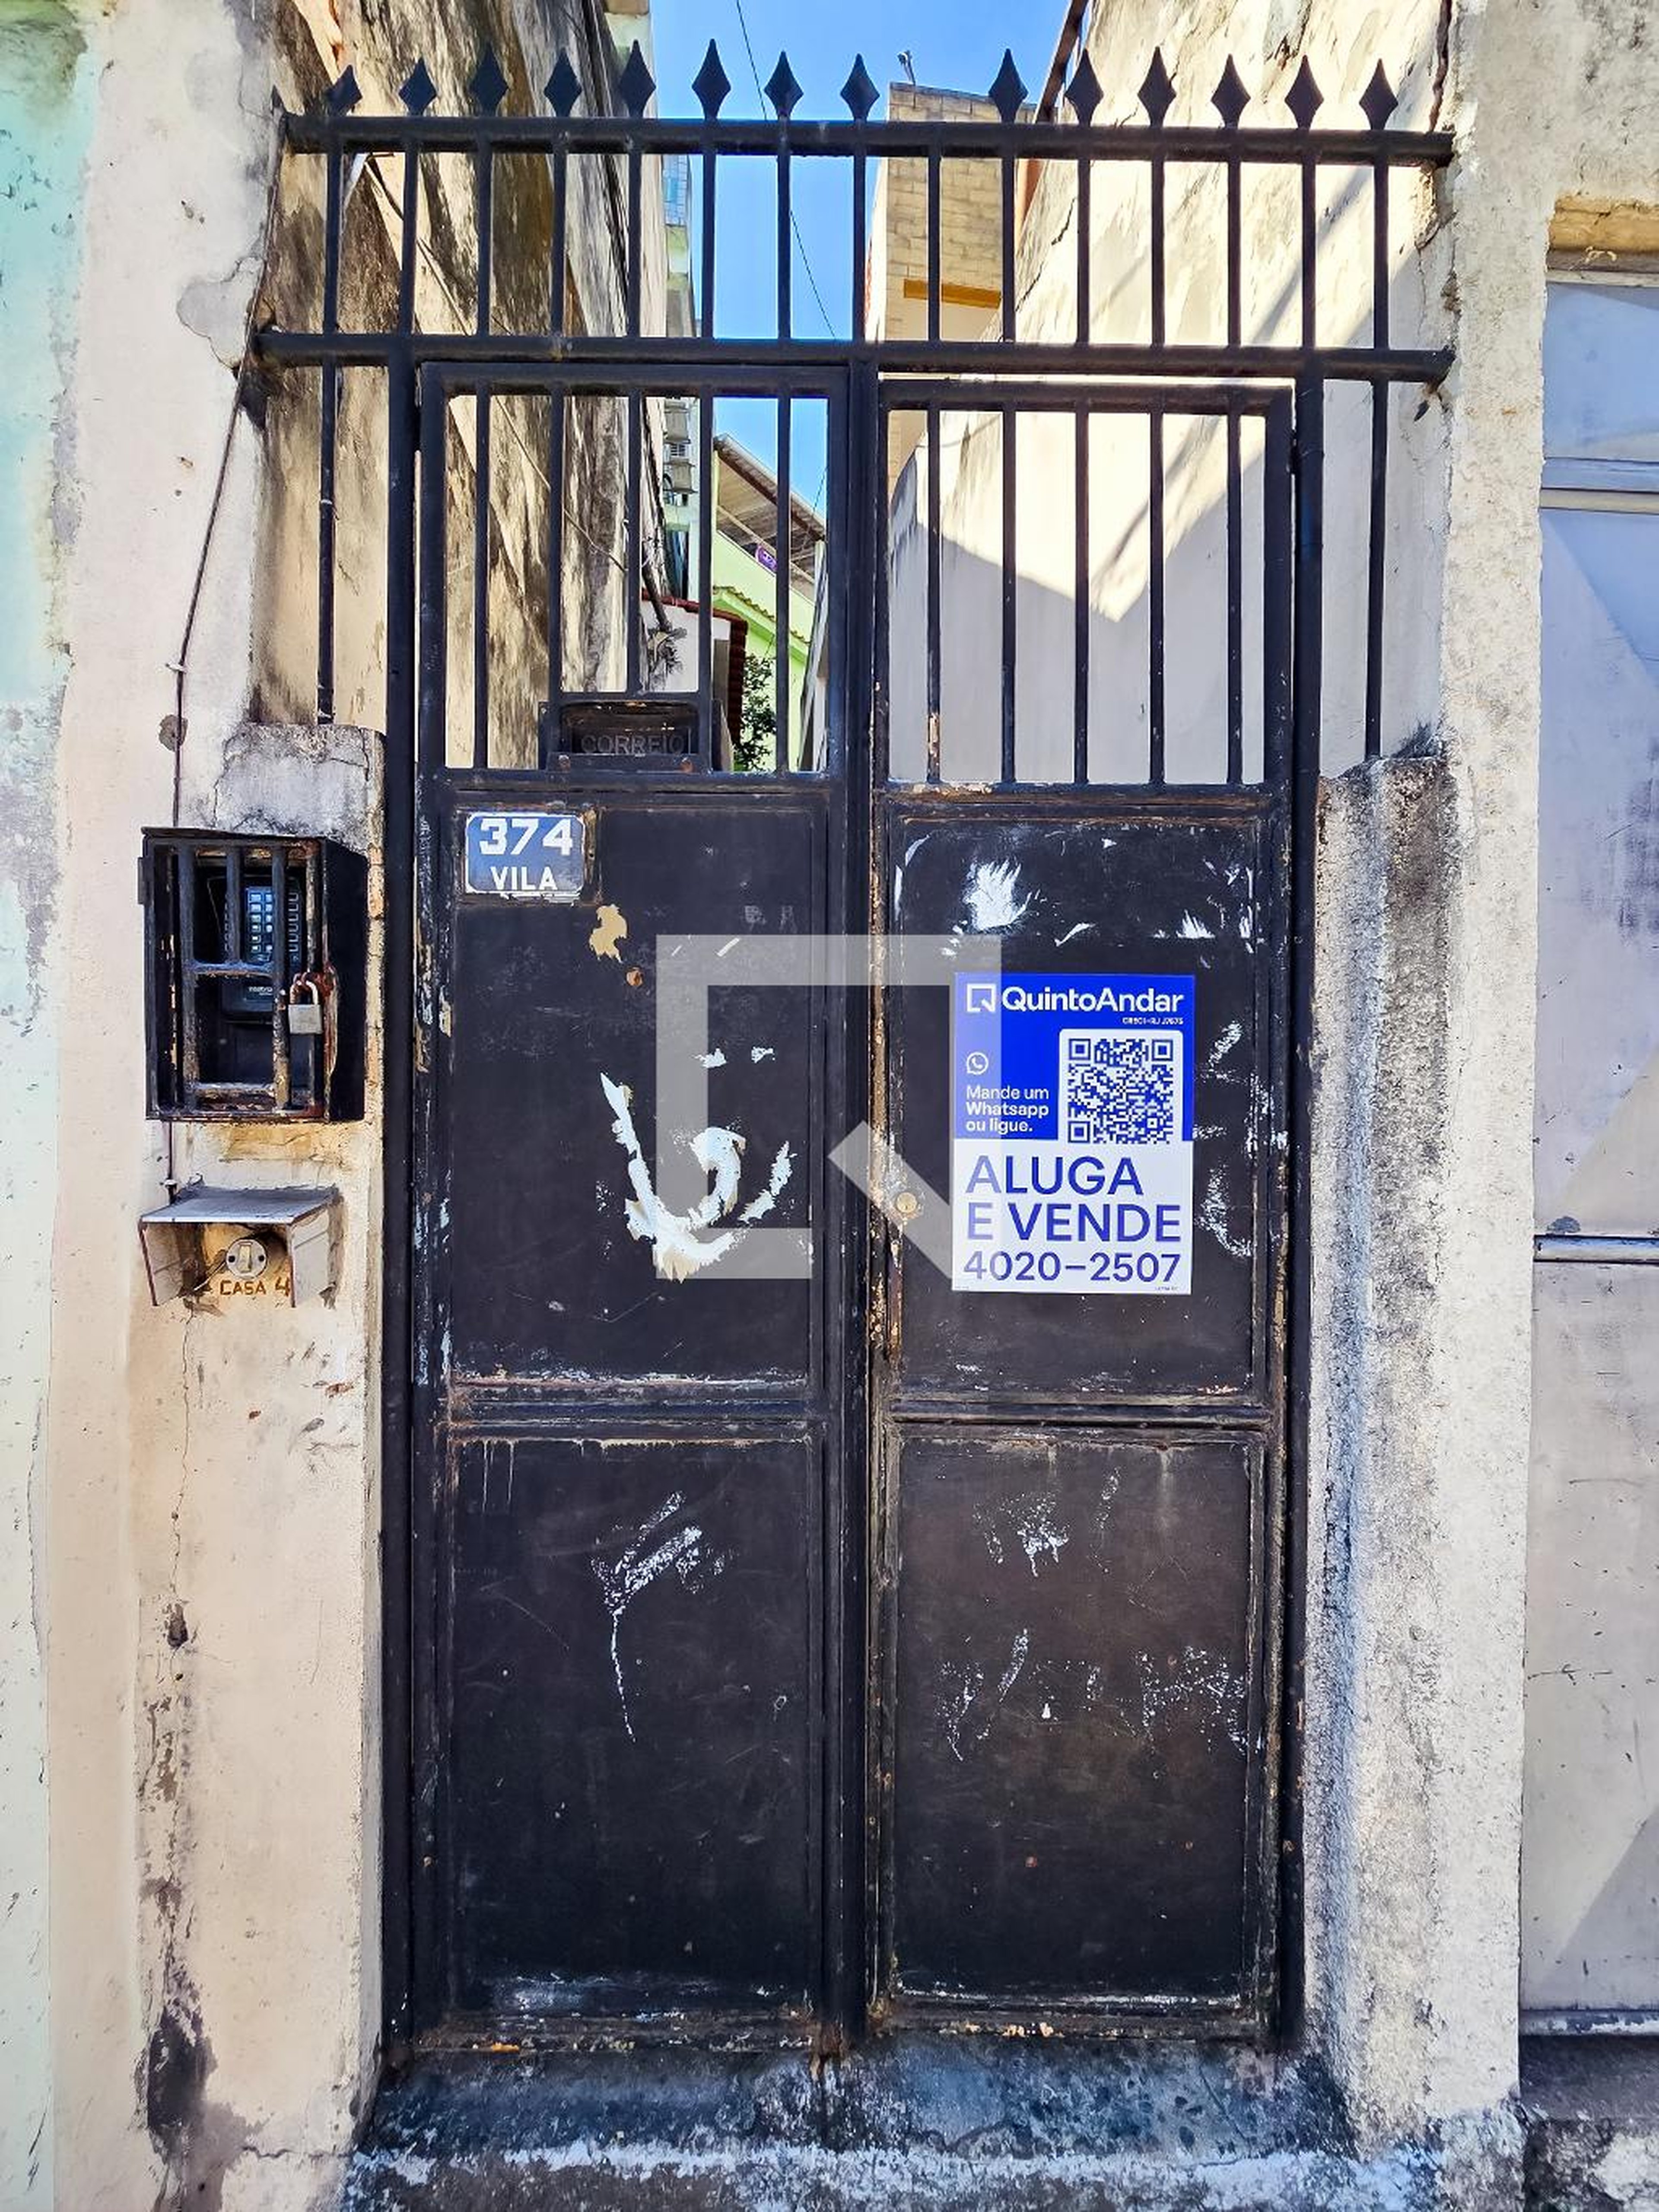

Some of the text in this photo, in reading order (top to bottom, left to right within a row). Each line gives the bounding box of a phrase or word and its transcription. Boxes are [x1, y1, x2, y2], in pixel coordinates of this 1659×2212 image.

[581, 735, 684, 754] CORREIO
[480, 818, 573, 855] 374
[490, 866, 558, 890] VILA
[1002, 987, 1184, 1012] QuintoAndar
[966, 1085, 1049, 1099] Mande um
[966, 1101, 1049, 1118] Whatsapp
[966, 1118, 1033, 1135] ou ligue.
[965, 1155, 1144, 1196] ALUGA
[968, 1203, 1181, 1243] E VENDE
[963, 1251, 1182, 1282] 4020-2507
[220, 1277, 290, 1296] CASA 4
